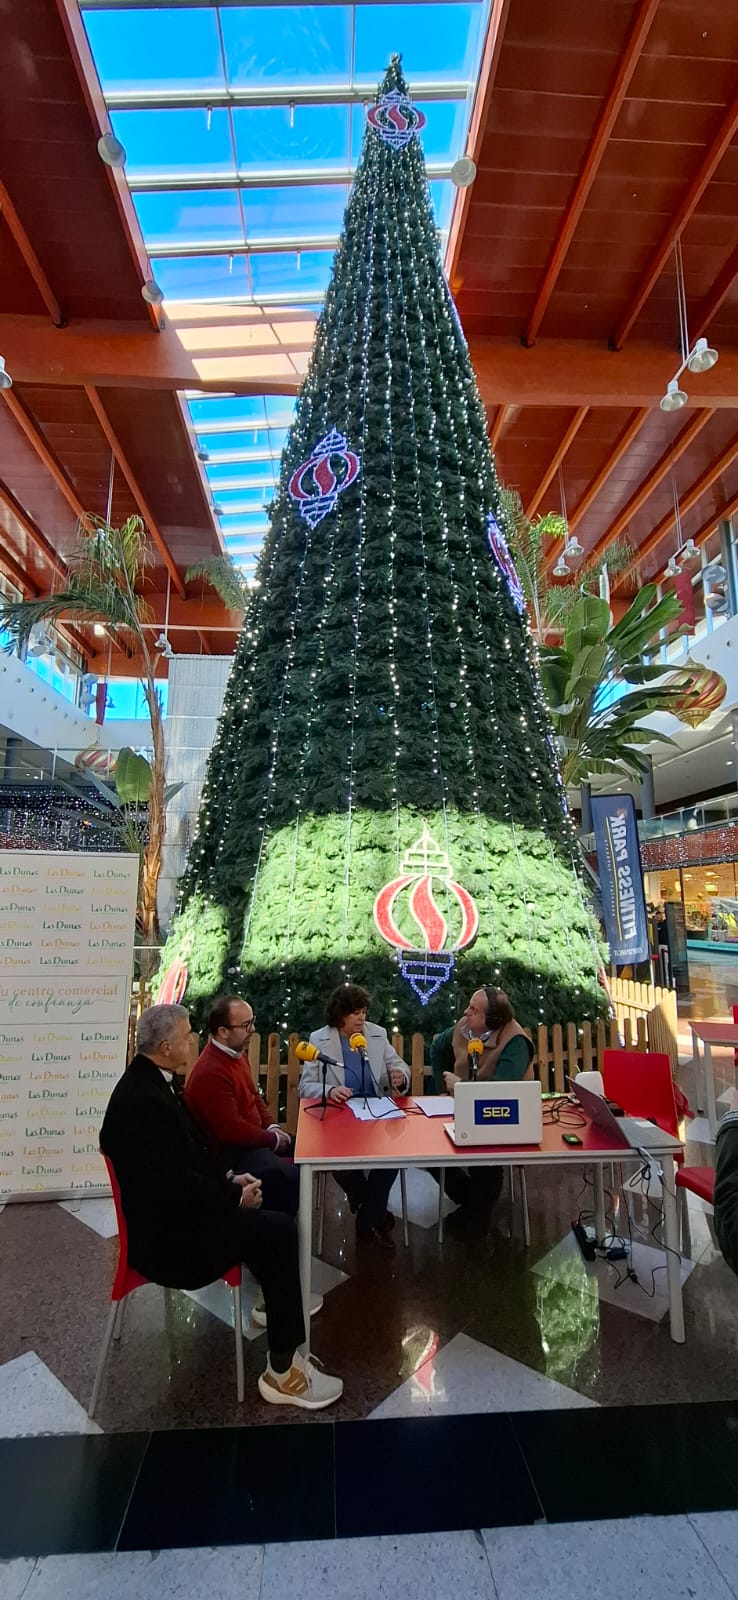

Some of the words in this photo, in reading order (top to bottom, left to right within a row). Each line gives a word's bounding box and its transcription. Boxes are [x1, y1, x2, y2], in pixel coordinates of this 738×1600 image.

[13, 987, 51, 997] centro
[58, 984, 118, 996] comercial
[8, 992, 21, 1013] de
[25, 993, 93, 1015] confianza
[482, 1106, 511, 1118] SER
